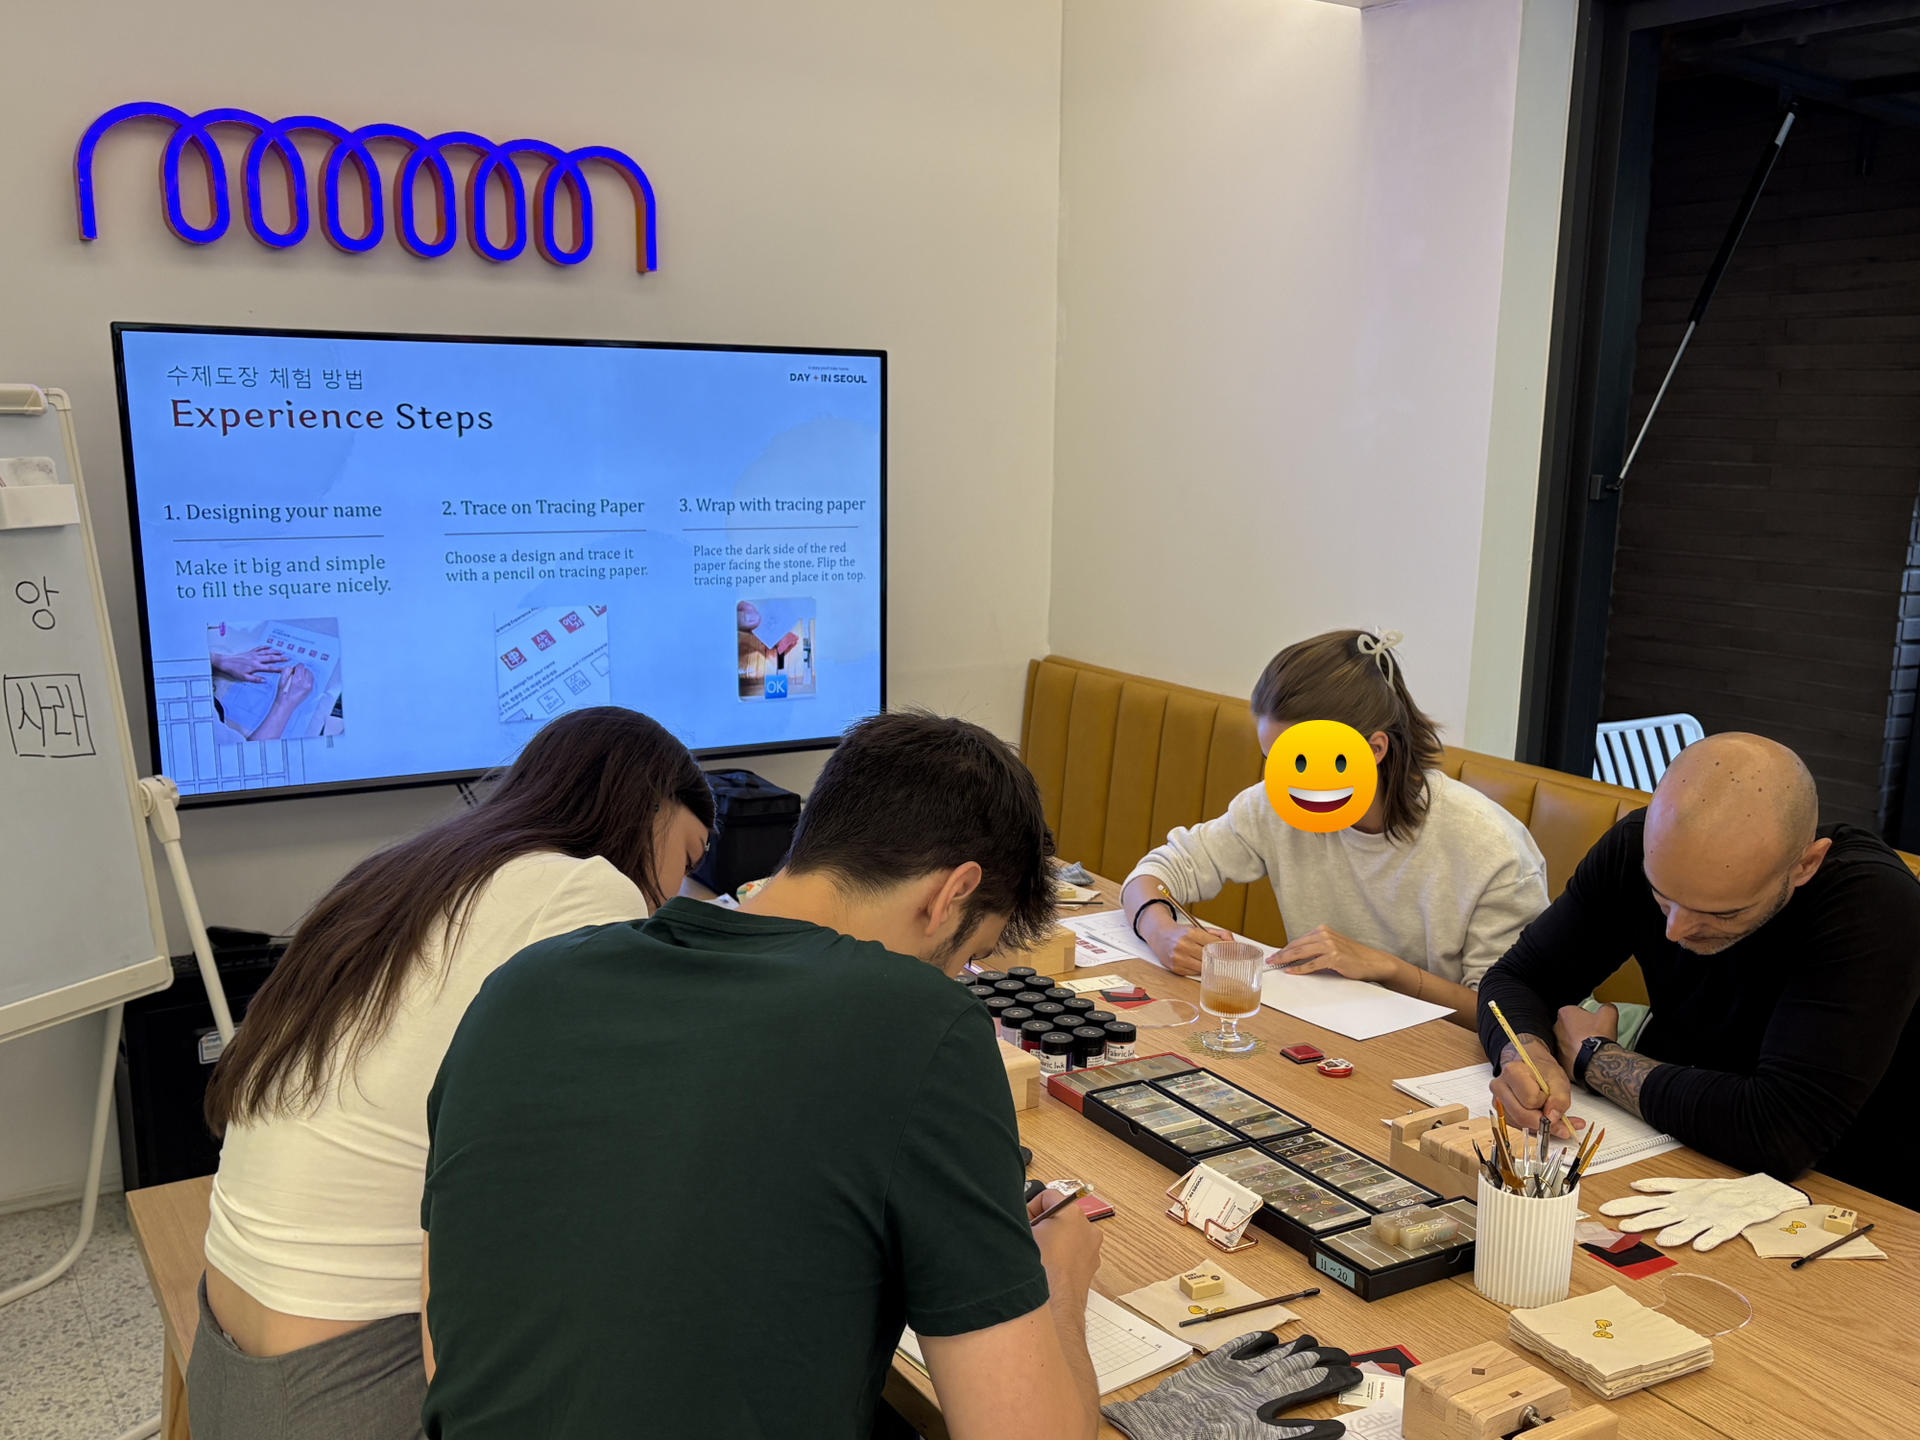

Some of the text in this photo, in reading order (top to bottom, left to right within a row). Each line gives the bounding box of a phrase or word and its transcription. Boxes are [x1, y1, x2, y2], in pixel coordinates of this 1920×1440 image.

[167, 365, 363, 390] 수제도장 체험 방법
[789, 373, 868, 384] DAY IN SEOUL
[170, 399, 493, 438] Experience Steps
[163, 503, 382, 524] 1. Designing your name
[441, 499, 645, 517] 2. Trace on Tracing Paper
[679, 497, 866, 515] 3. Wrap with tracing paper
[445, 547, 634, 565] Choose a design and trace it
[693, 542, 847, 557] Place the dark side of the red
[175, 554, 386, 577] Make it big and simple
[445, 565, 648, 583] with a pencil on tracing paper.
[693, 556, 856, 574] paper facing the stone. Flip the
[177, 576, 391, 600] to fill the square nicely.
[694, 571, 866, 588] tracing paper and place it on top.
[16, 576, 59, 630] 앙
[767, 681, 786, 693] OK
[16, 682, 84, 747] 사라
